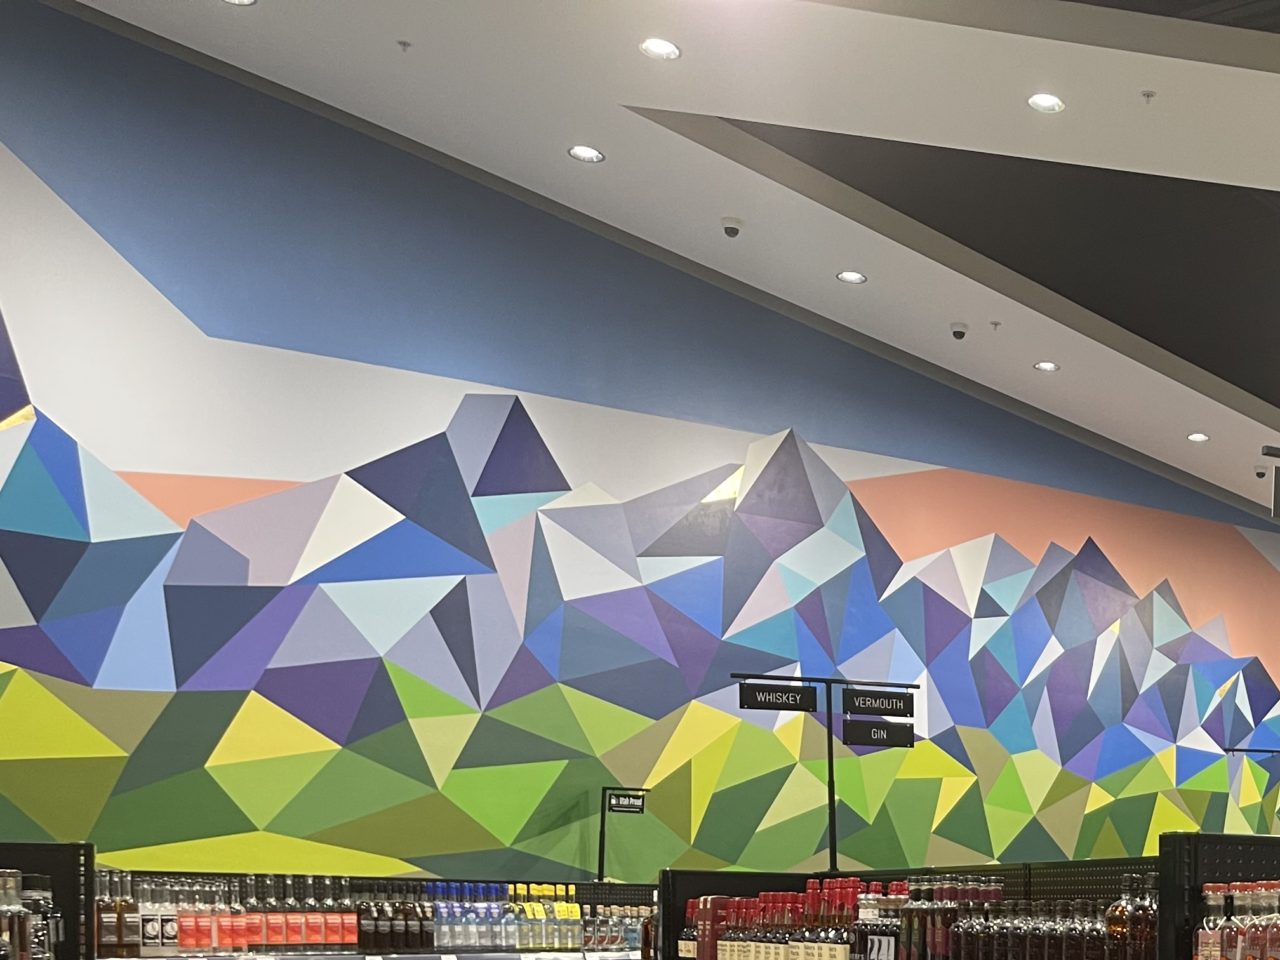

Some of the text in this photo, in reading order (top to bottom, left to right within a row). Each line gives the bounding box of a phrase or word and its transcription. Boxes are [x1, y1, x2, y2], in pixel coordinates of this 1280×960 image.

[756, 691, 802, 705] WHISKEY
[853, 696, 905, 710] VERMOUTH
[870, 728, 888, 740] GIN
